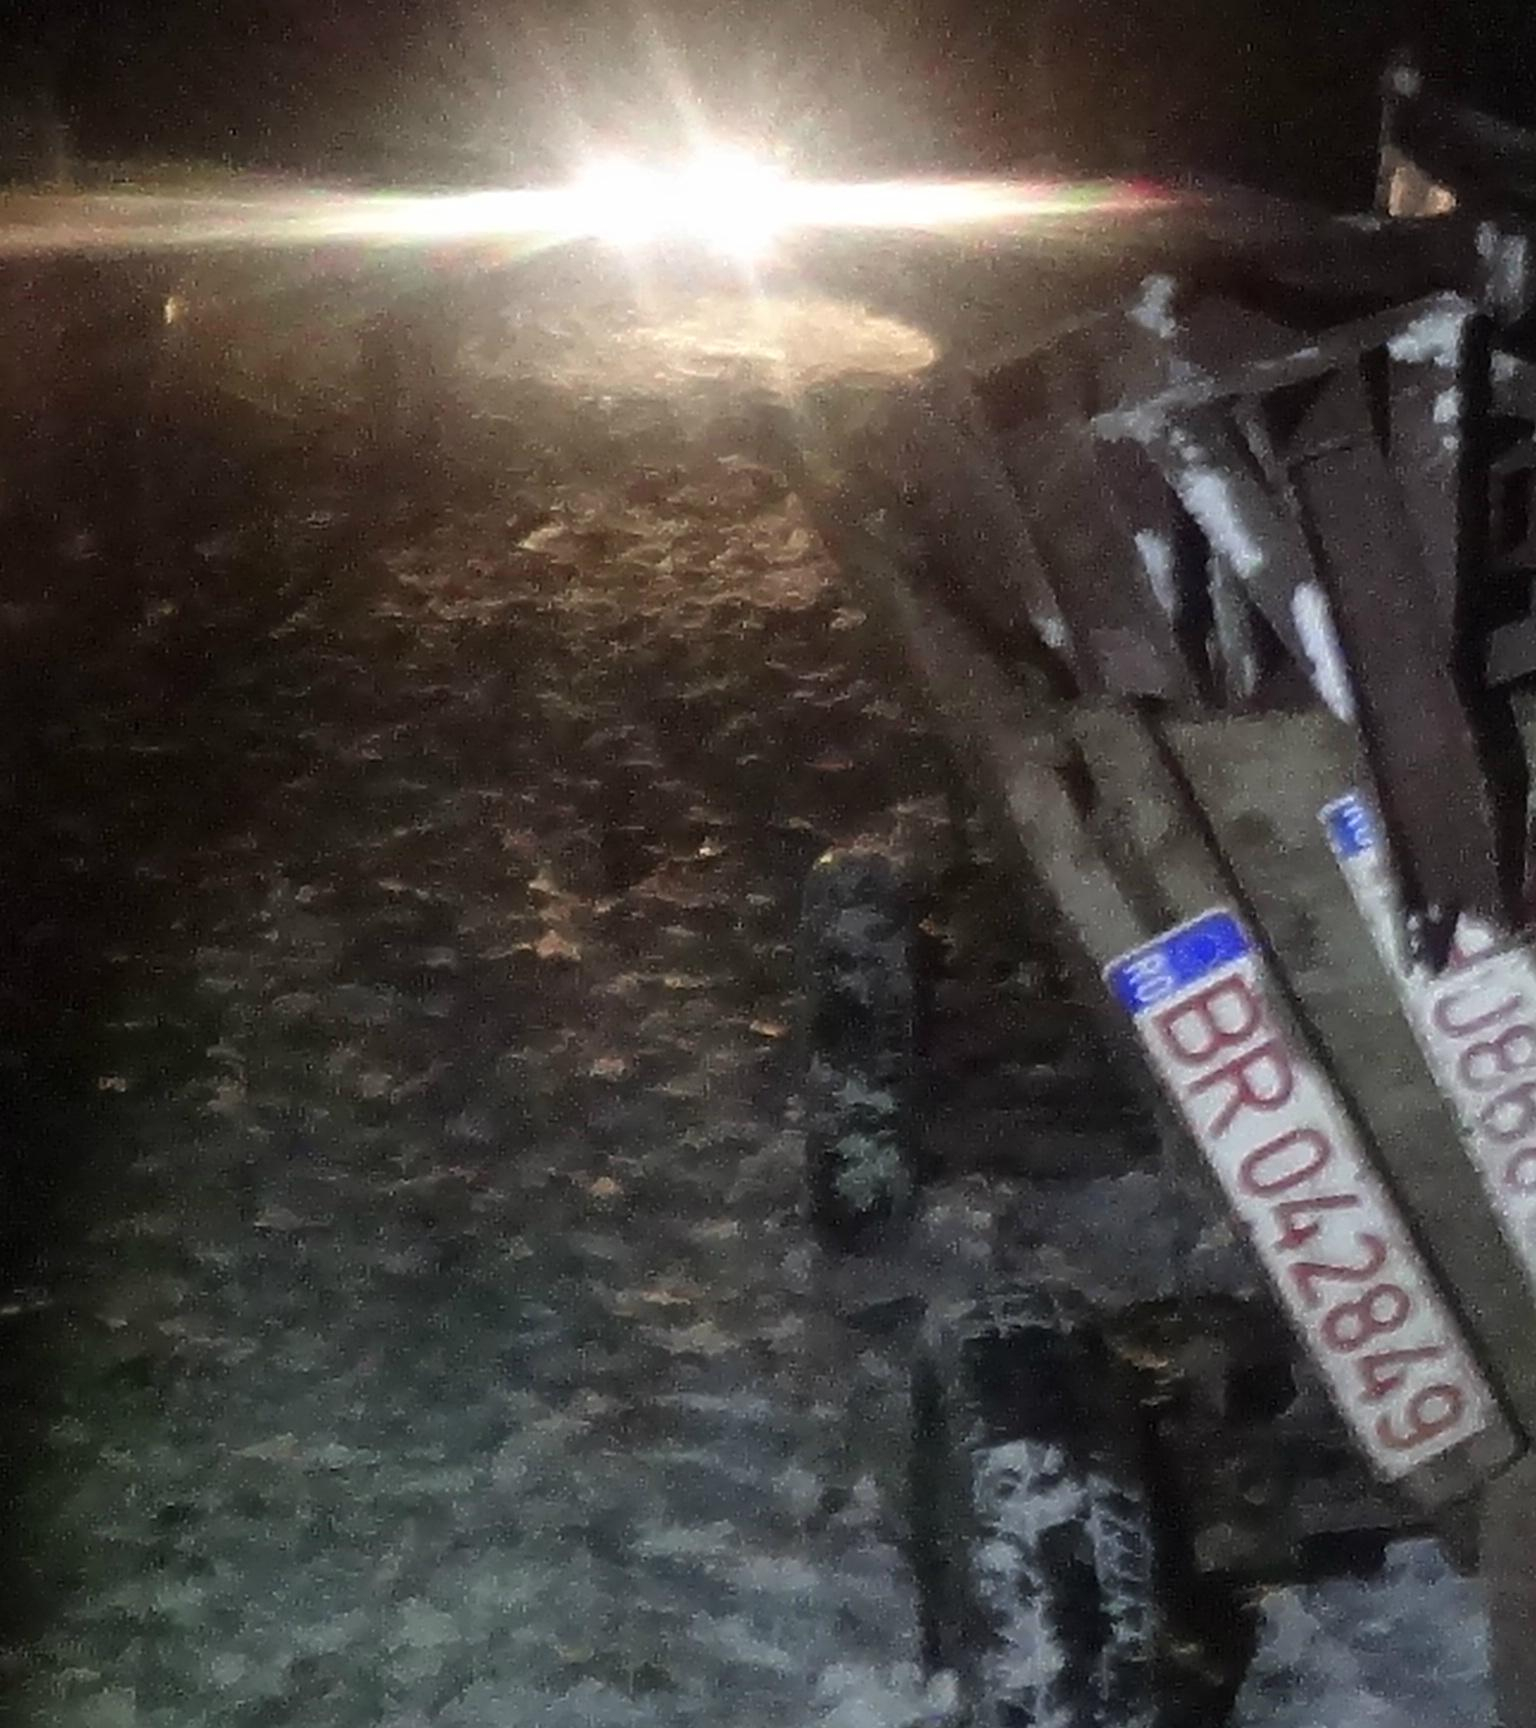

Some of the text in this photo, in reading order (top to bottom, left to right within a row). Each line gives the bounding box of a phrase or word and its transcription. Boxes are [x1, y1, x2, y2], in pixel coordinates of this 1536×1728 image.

[1122, 951, 1178, 1003] RO
[1152, 973, 1471, 1451] BR 042849
